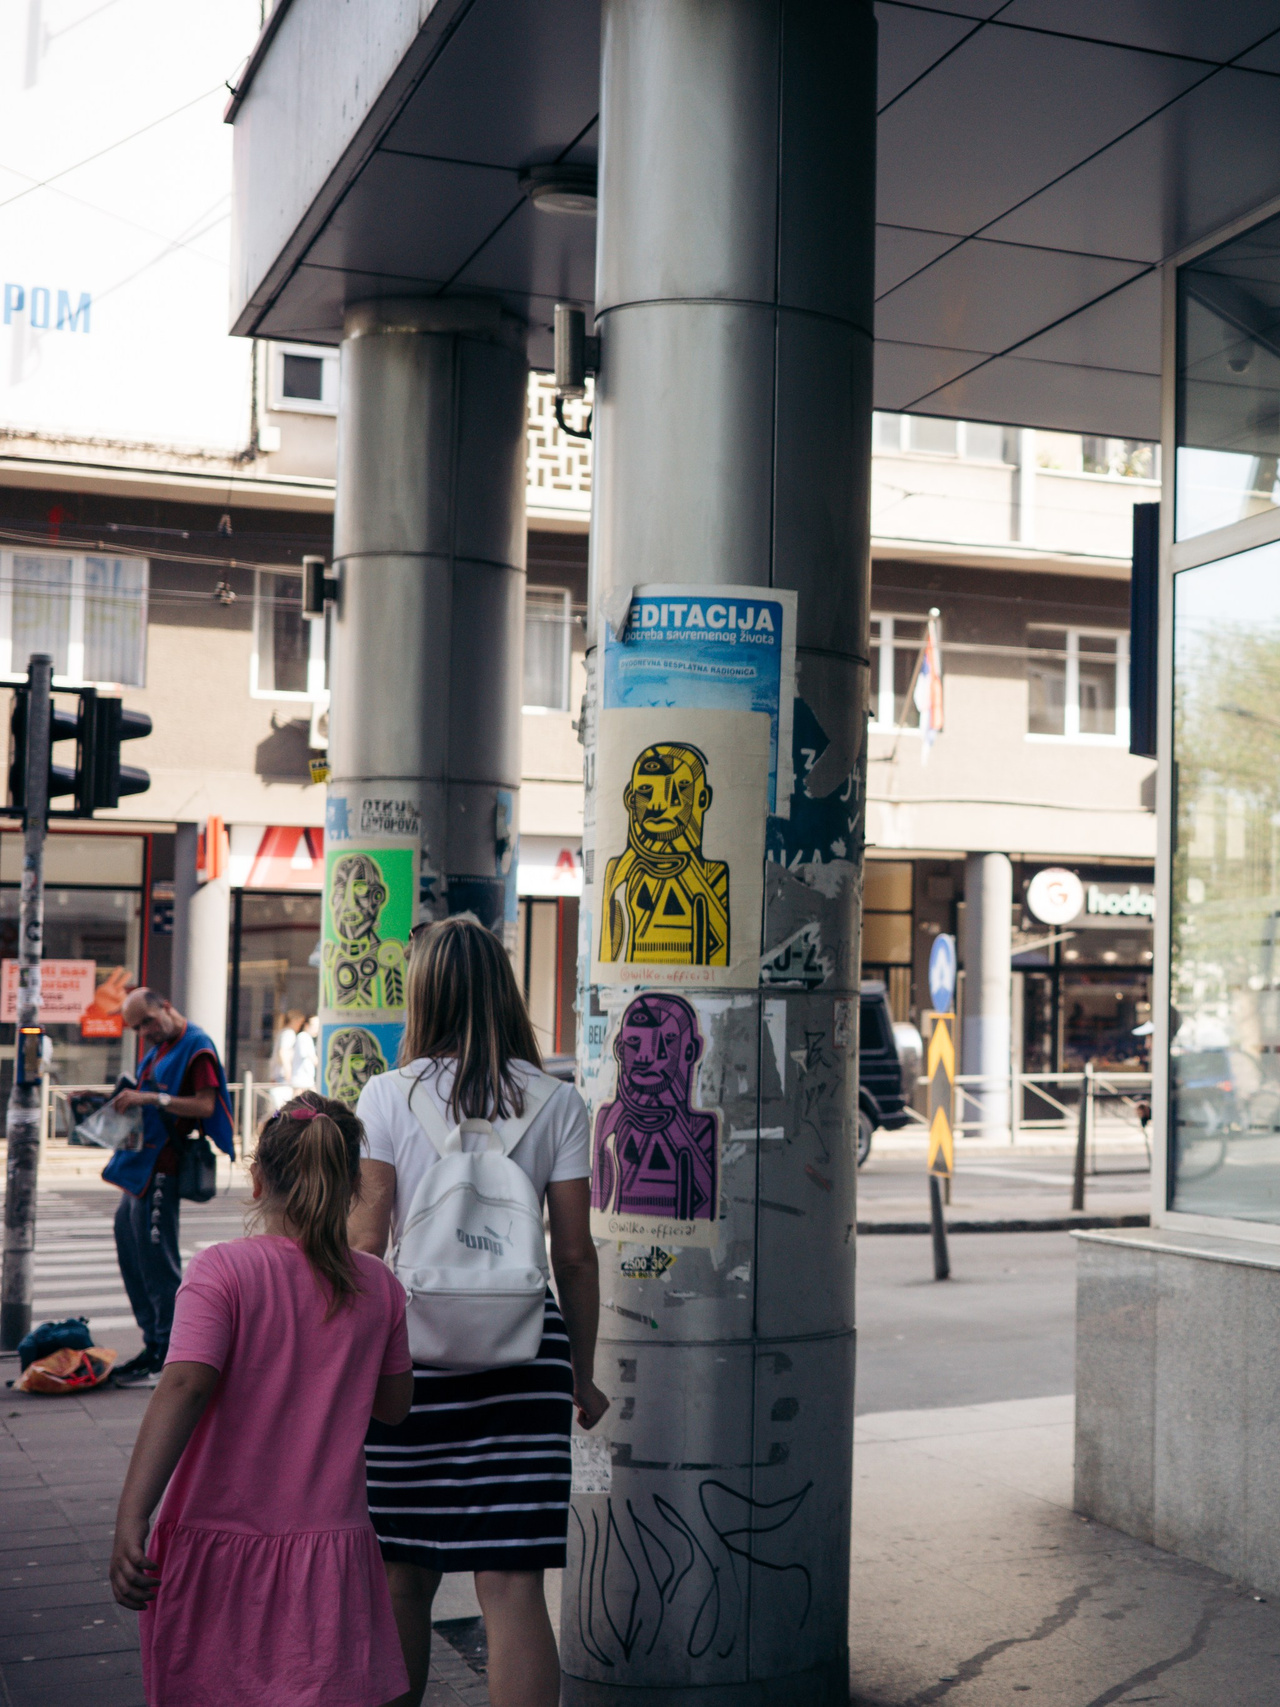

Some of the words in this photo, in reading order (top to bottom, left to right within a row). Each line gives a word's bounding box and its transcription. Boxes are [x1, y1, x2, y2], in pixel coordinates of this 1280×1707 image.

[630, 603, 775, 632] EDITACIJA
[626, 627, 663, 643] potreba
[666, 630, 736, 645] savremenog
[740, 630, 774, 645] života
[663, 661, 708, 673] BESPLATNA
[710, 666, 755, 676] RADIONICA
